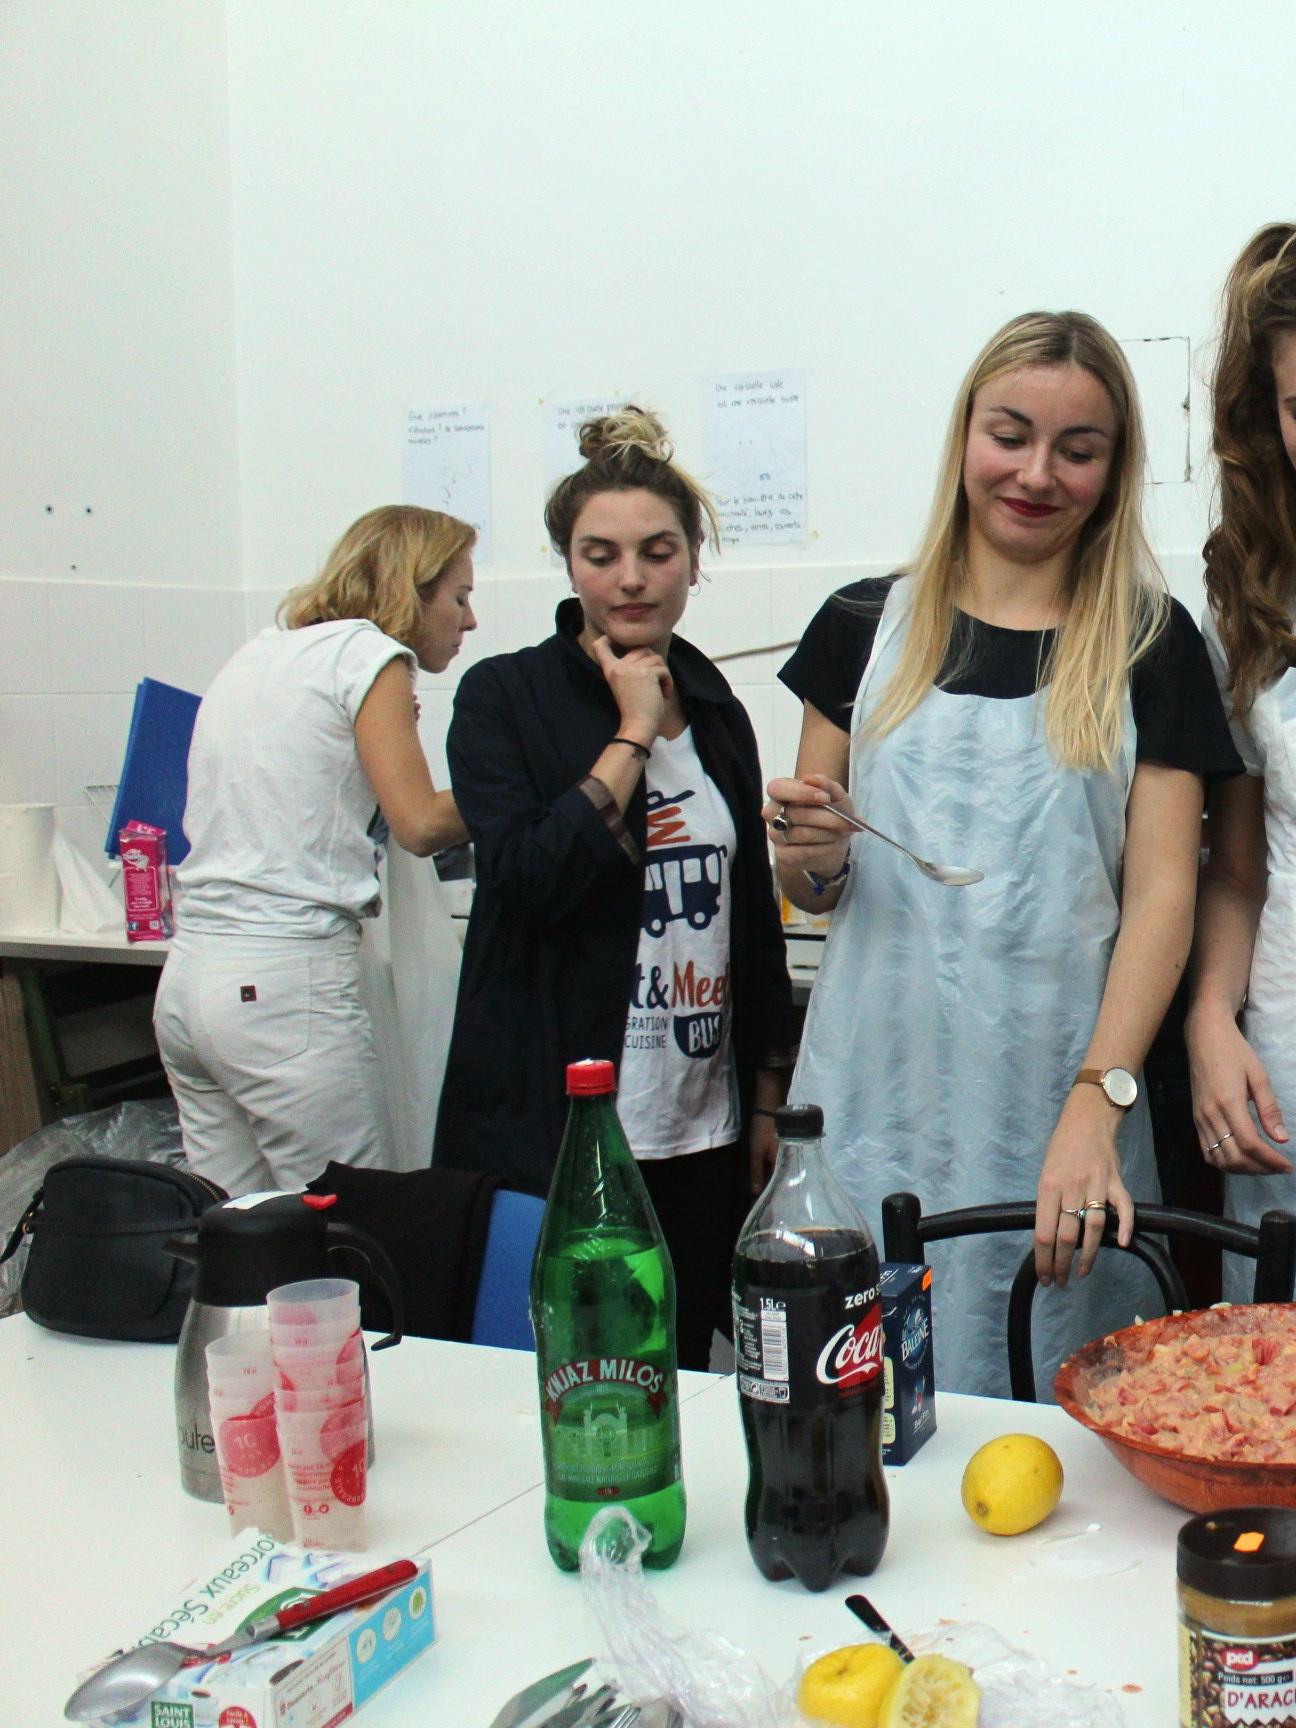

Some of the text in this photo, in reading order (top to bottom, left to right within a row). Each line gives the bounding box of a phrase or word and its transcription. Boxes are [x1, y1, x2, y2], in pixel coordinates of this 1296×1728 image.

[844, 1288, 875, 1311] zero
[545, 1360, 594, 1402] KNJAZ
[199, 1535, 276, 1599] orceaux
[1260, 1675, 1275, 1684] 500
[154, 1704, 190, 1719] SAINT
